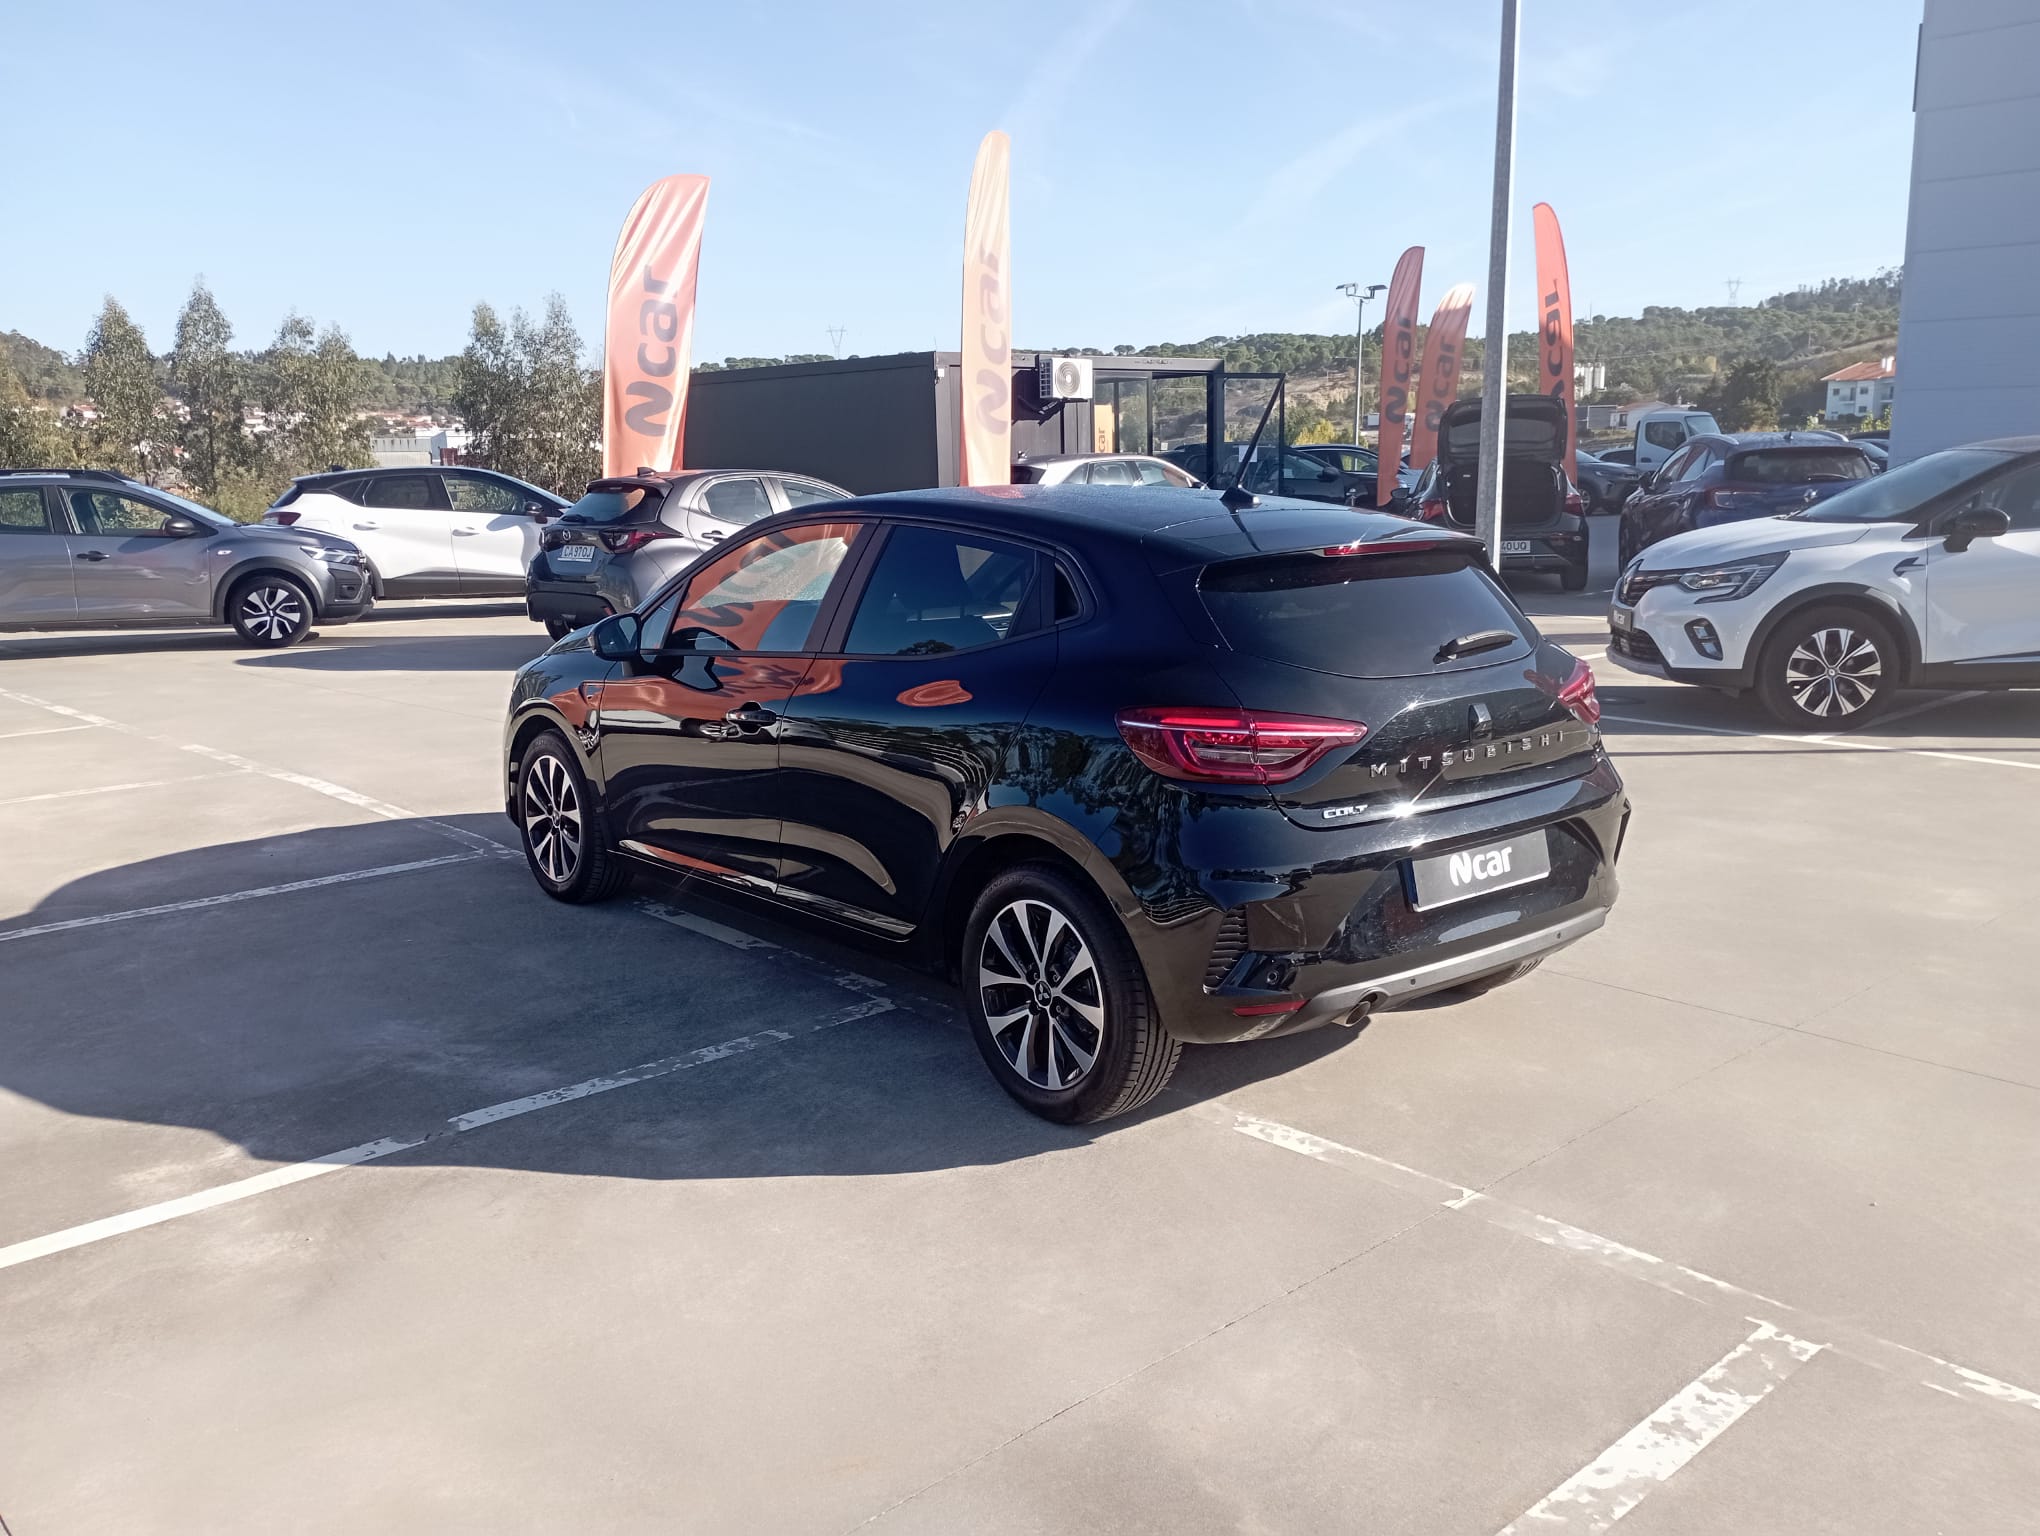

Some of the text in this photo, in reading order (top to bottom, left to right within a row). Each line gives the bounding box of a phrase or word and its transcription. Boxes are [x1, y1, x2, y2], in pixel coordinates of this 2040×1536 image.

[625, 264, 678, 438] Ncar
[976, 239, 1009, 436] Ncar
[1385, 309, 1412, 425] Ncar
[1370, 730, 1564, 778] MITSUBISHI
[1323, 804, 1369, 819] COLT
[1450, 846, 1512, 887] Ncar
